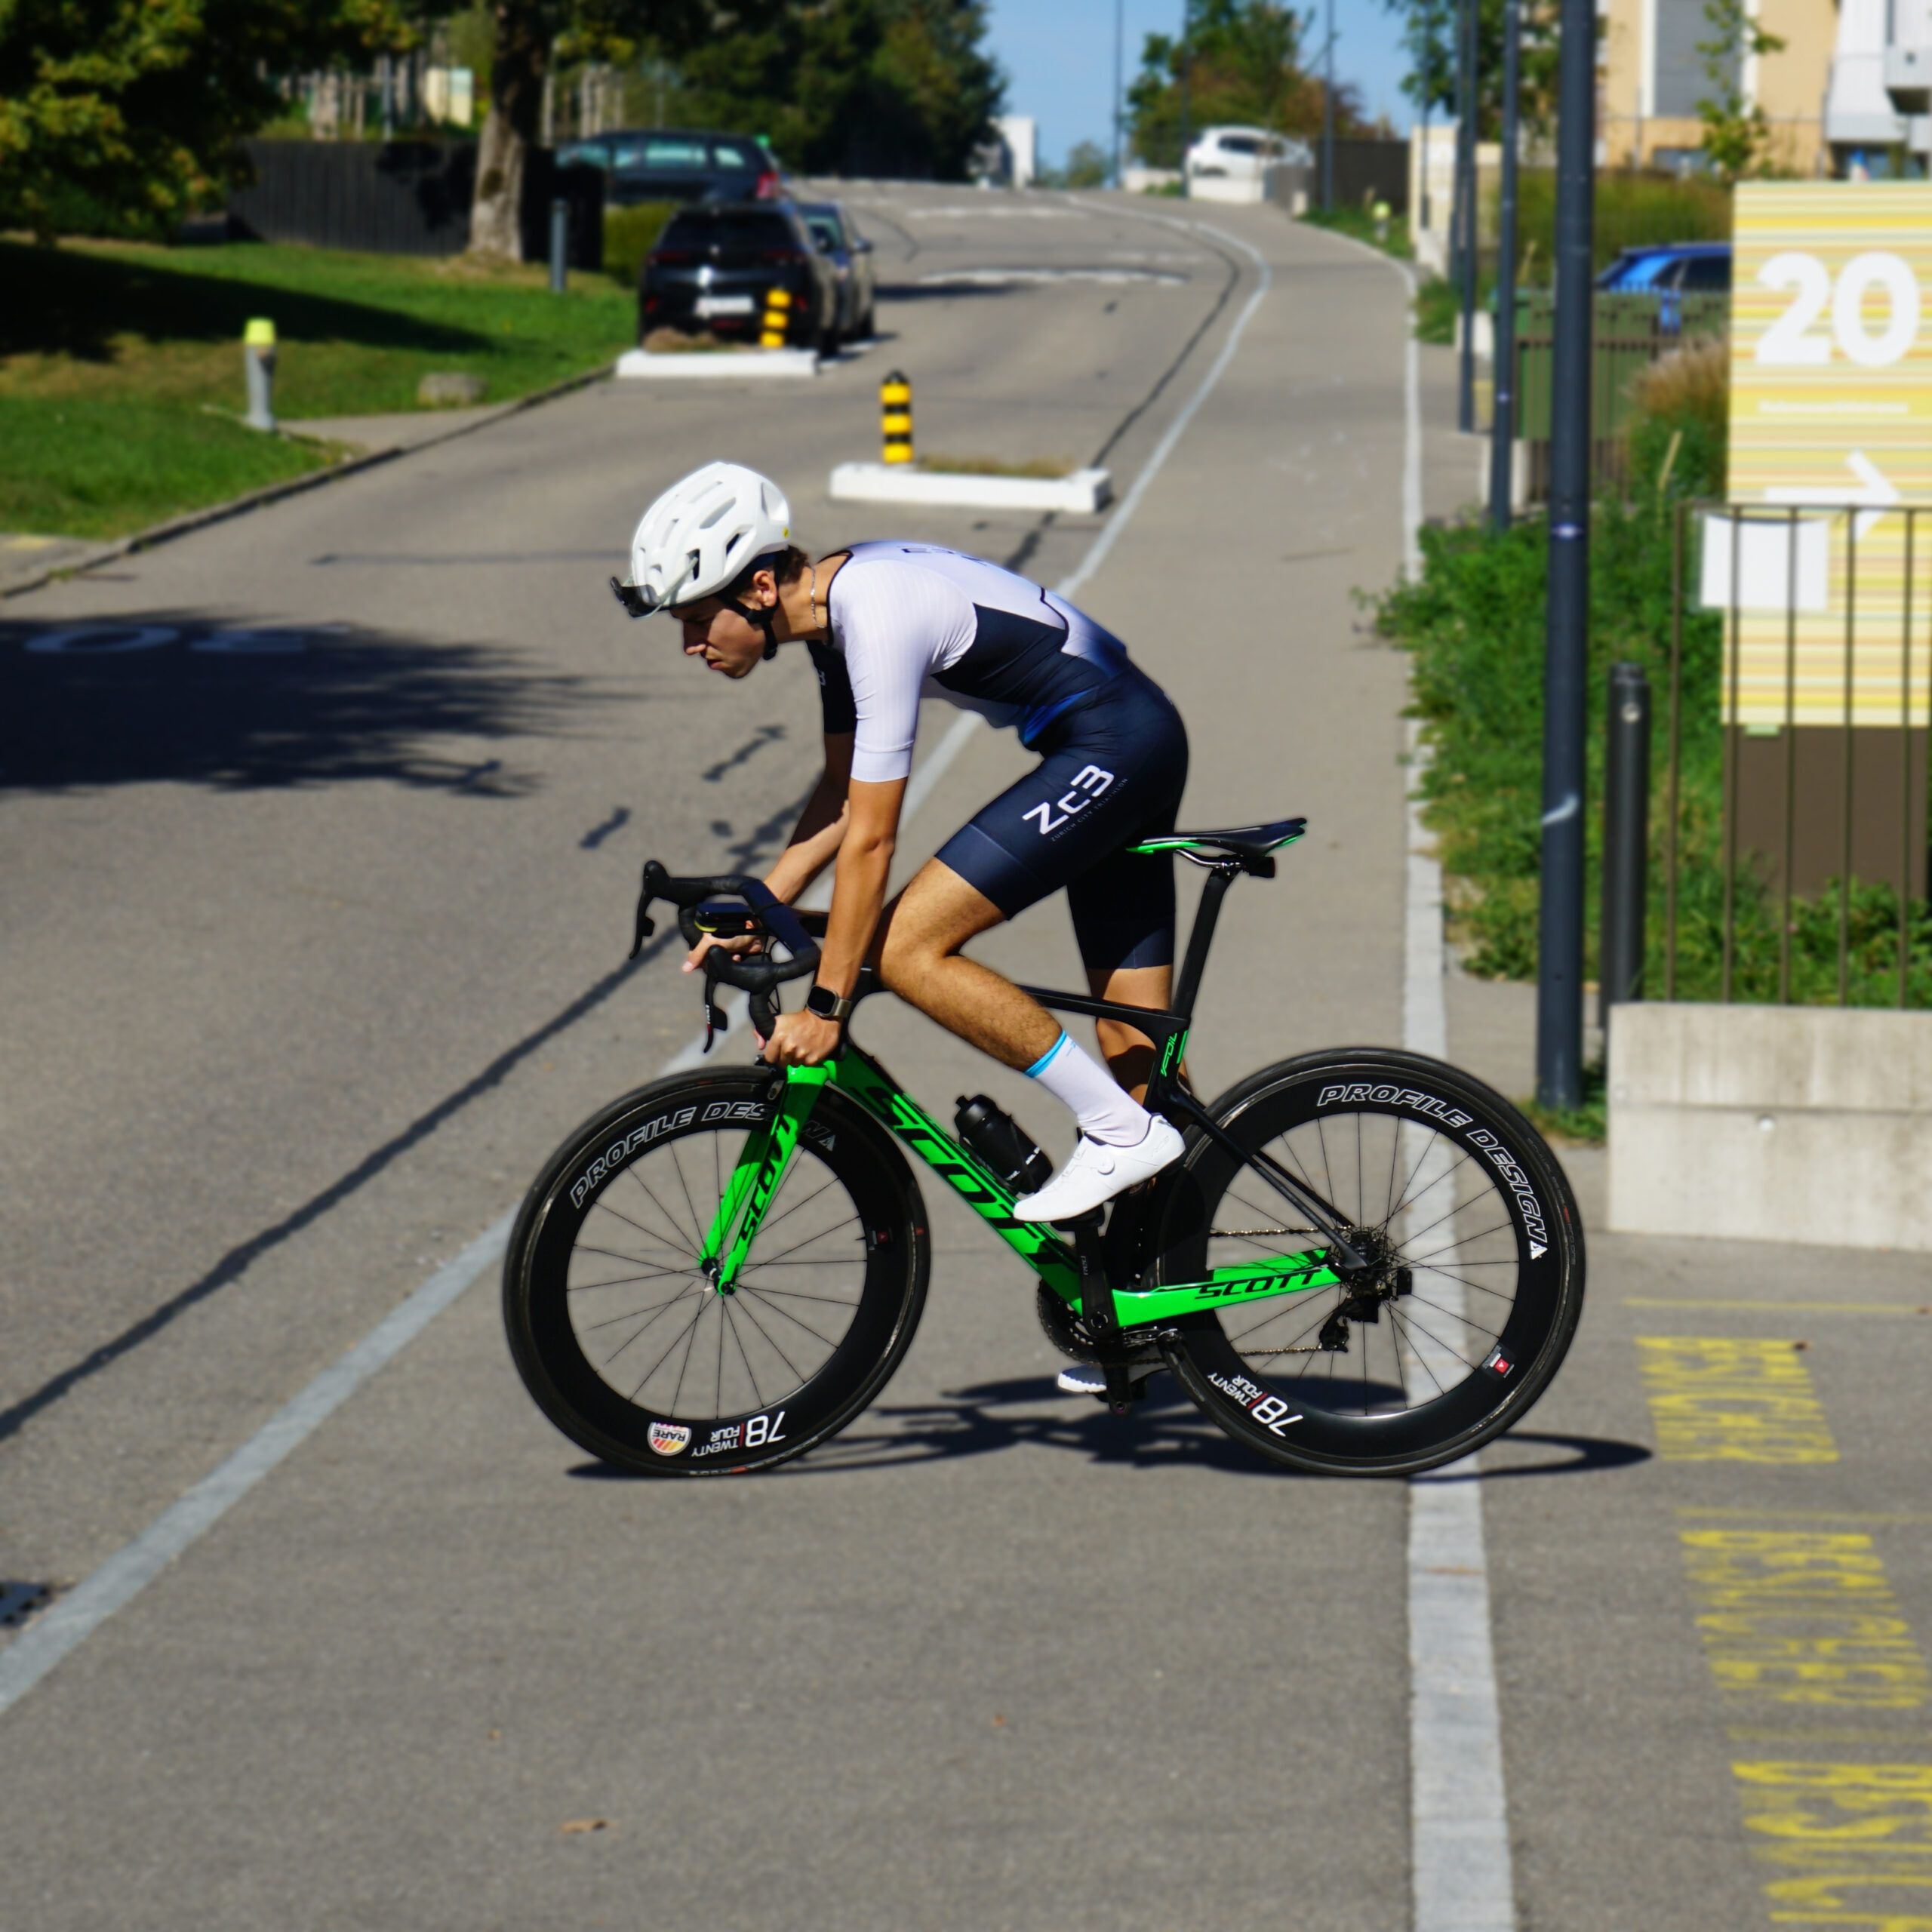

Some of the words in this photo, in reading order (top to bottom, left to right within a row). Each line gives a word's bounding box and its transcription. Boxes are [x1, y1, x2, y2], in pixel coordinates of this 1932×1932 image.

[1754, 251, 1921, 366] 20
[570, 1106, 696, 1208] PROFILE
[1317, 1084, 1472, 1127] PROFILE
[1466, 1129, 1548, 1244] DESIGN
[859, 1085, 1066, 1266] SCOTT
[1194, 1267, 1323, 1300] SCOTT
[1208, 1372, 1247, 1406] TWENTY
[1232, 1375, 1263, 1399] FOUR
[710, 1426, 740, 1442] FOUR
[746, 1411, 786, 1447] 78
[1251, 1396, 1303, 1437] 78
[653, 1429, 686, 1442] RARE
[691, 1438, 738, 1457] TWENTY
